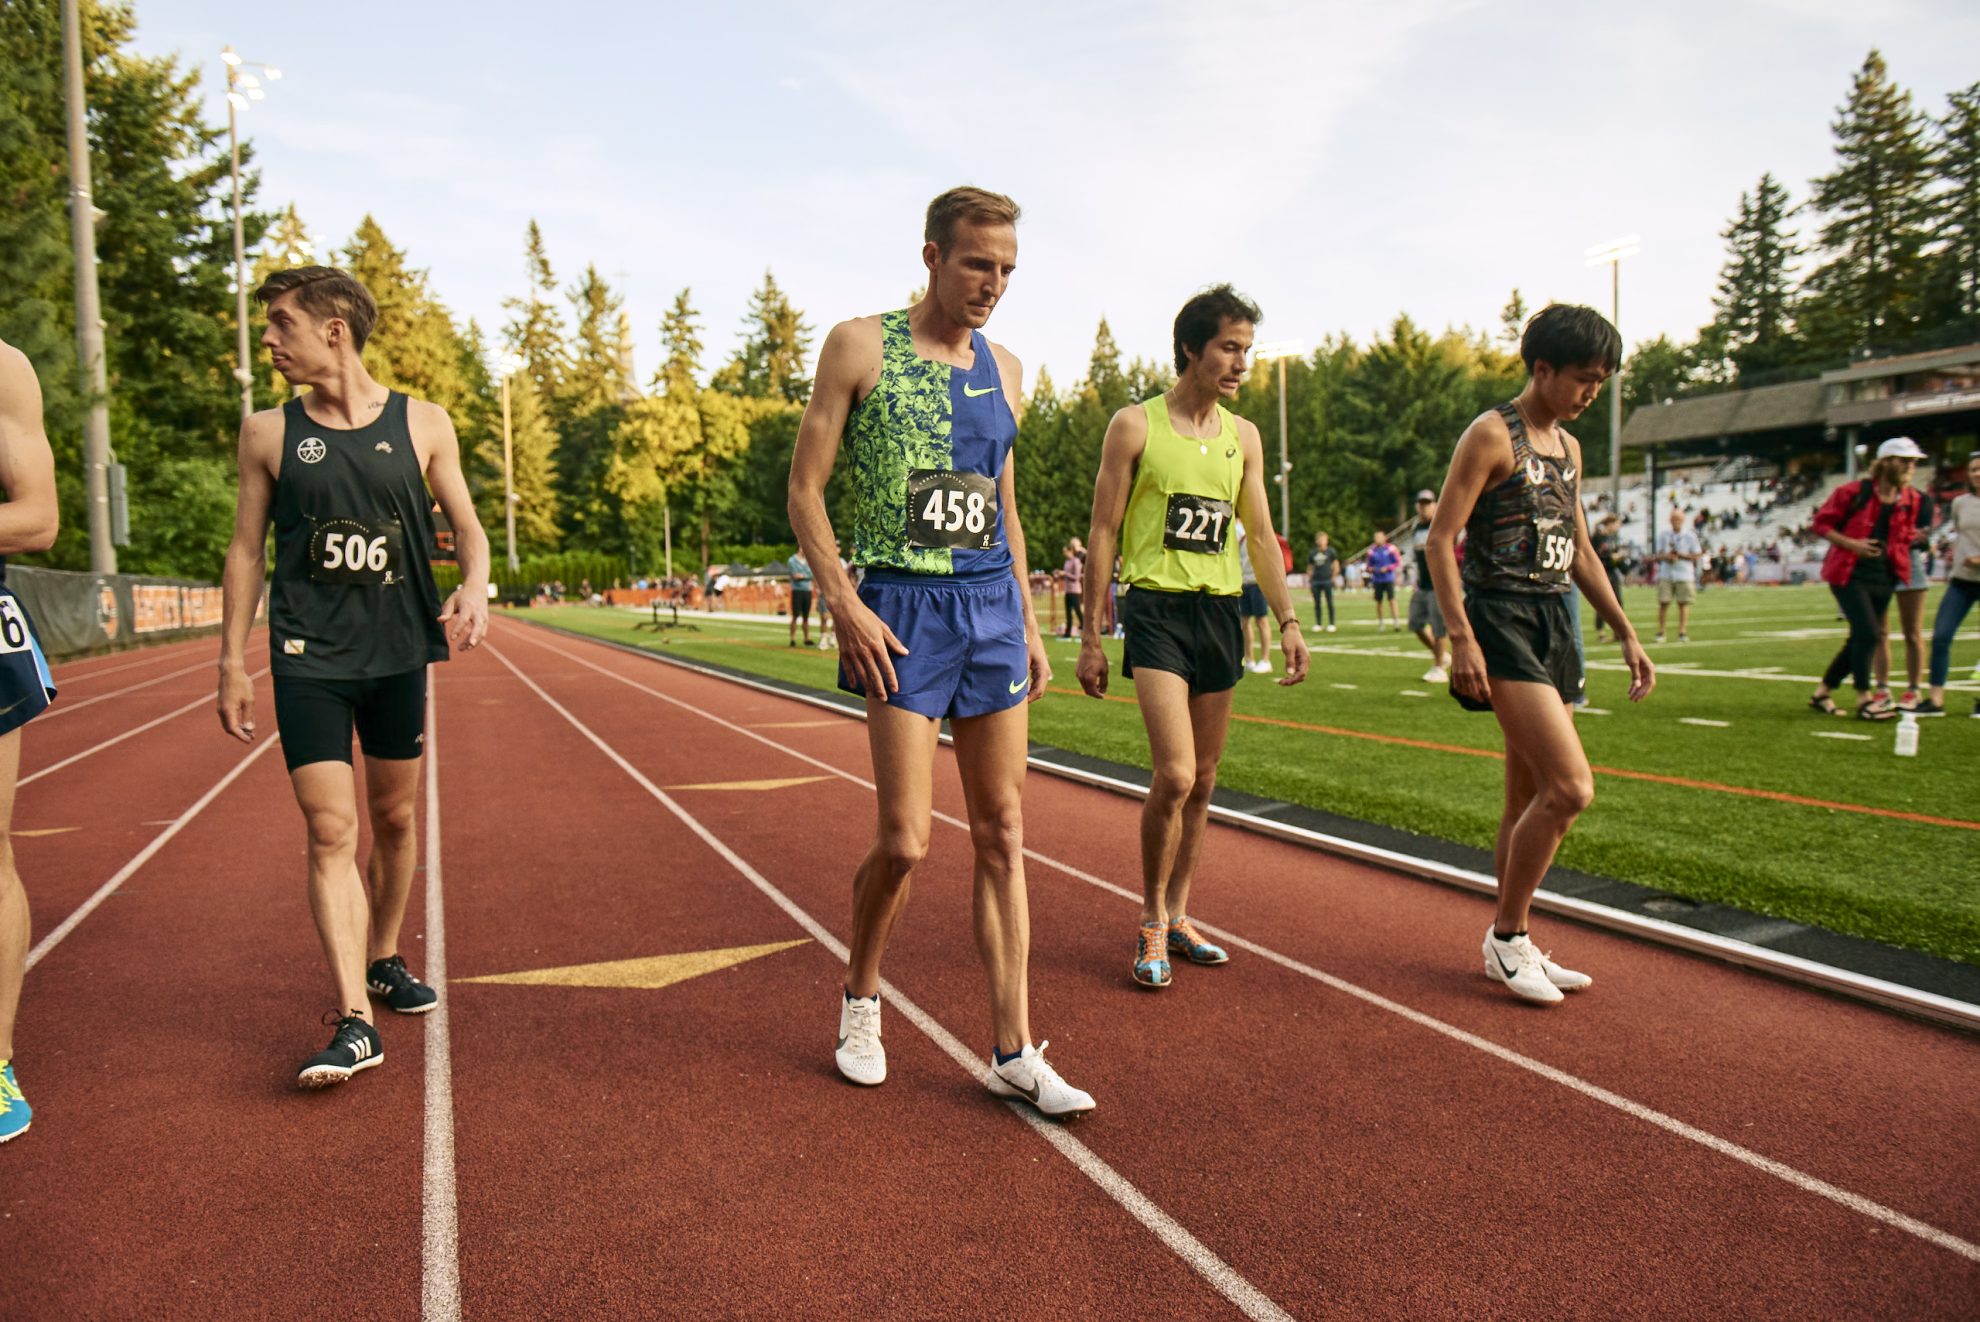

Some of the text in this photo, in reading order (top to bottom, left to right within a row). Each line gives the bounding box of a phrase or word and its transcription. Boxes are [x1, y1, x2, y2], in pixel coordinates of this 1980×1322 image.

[922, 489, 986, 534] 458
[1175, 507, 1223, 543] 221
[323, 532, 388, 572] 506
[1542, 534, 1574, 571] 550
[0, 600, 25, 648] 6
